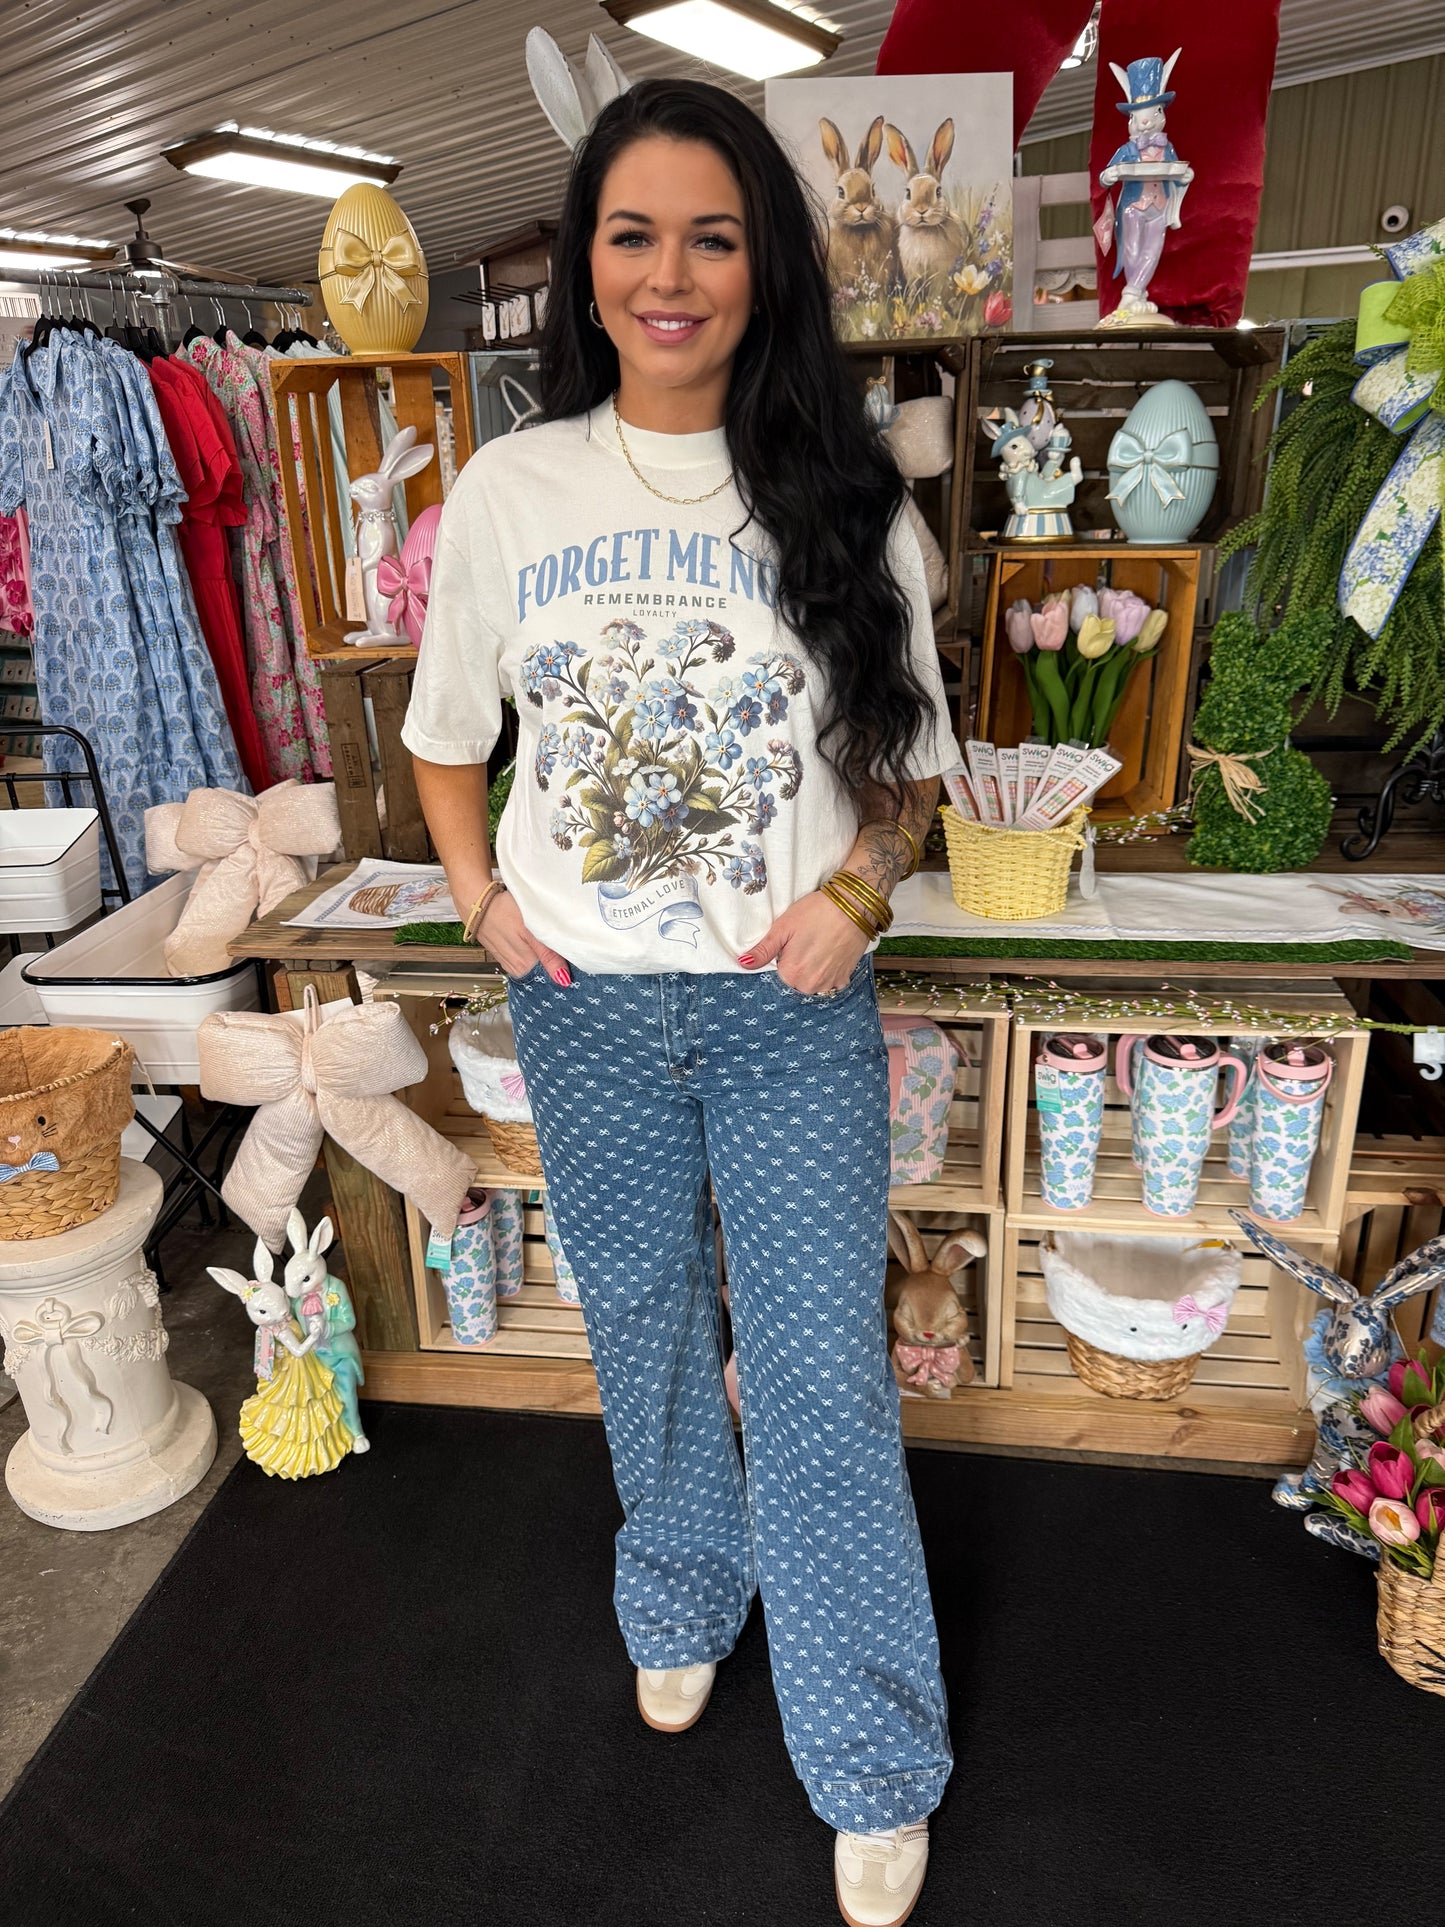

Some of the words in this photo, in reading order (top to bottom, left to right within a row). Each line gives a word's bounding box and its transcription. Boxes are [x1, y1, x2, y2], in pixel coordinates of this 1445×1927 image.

[518, 528, 660, 624] FORGET
[666, 528, 721, 589] ME
[729, 545, 778, 609] NO
[583, 592, 728, 609] REMEMBRANCE
[632, 609, 678, 618] LOYALTY
[612, 897, 655, 919] ETERNAL
[656, 879, 685, 898] LOVE
